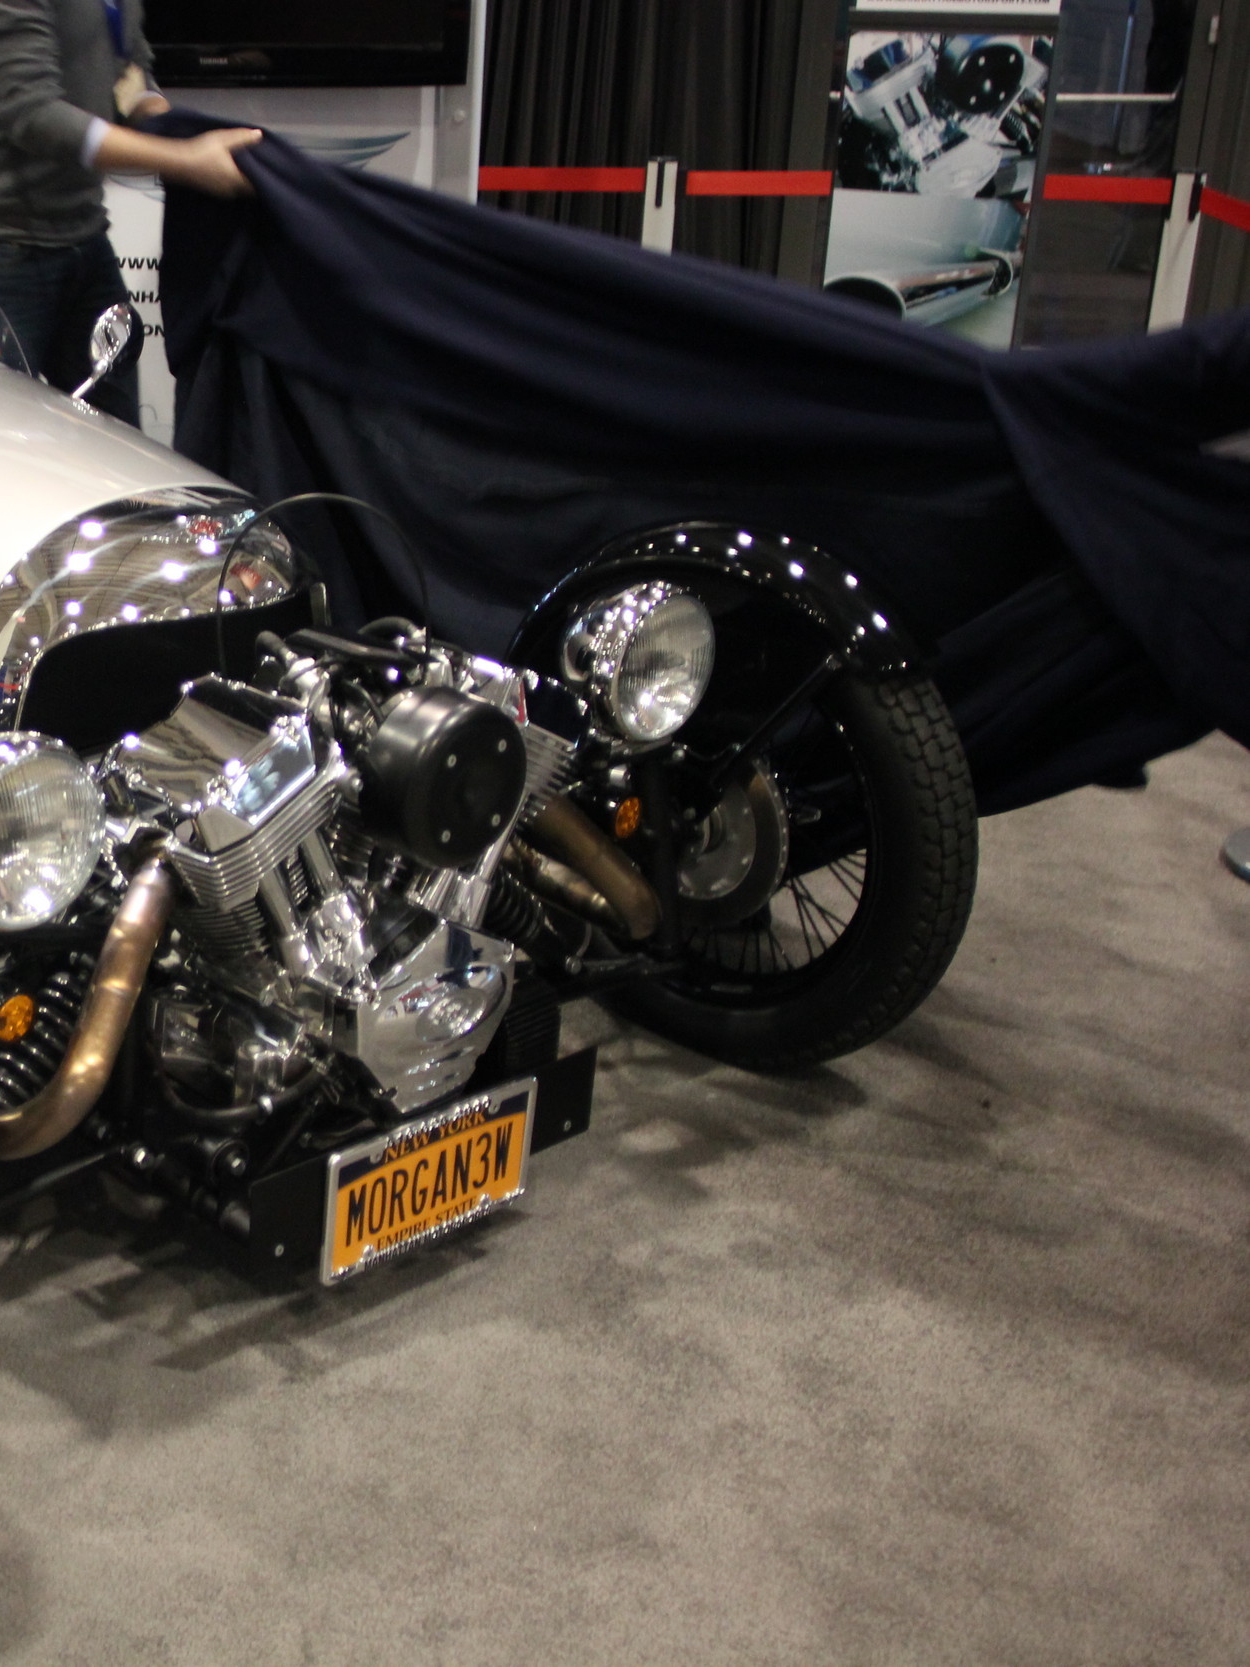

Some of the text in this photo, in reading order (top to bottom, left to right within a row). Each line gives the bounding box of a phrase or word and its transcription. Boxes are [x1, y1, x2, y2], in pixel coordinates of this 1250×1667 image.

[384, 1131, 430, 1164] NEW
[439, 1110, 486, 1139] YORK
[345, 1121, 514, 1248] MORGAN3W
[377, 1196, 478, 1252] EMPIRE STATE
